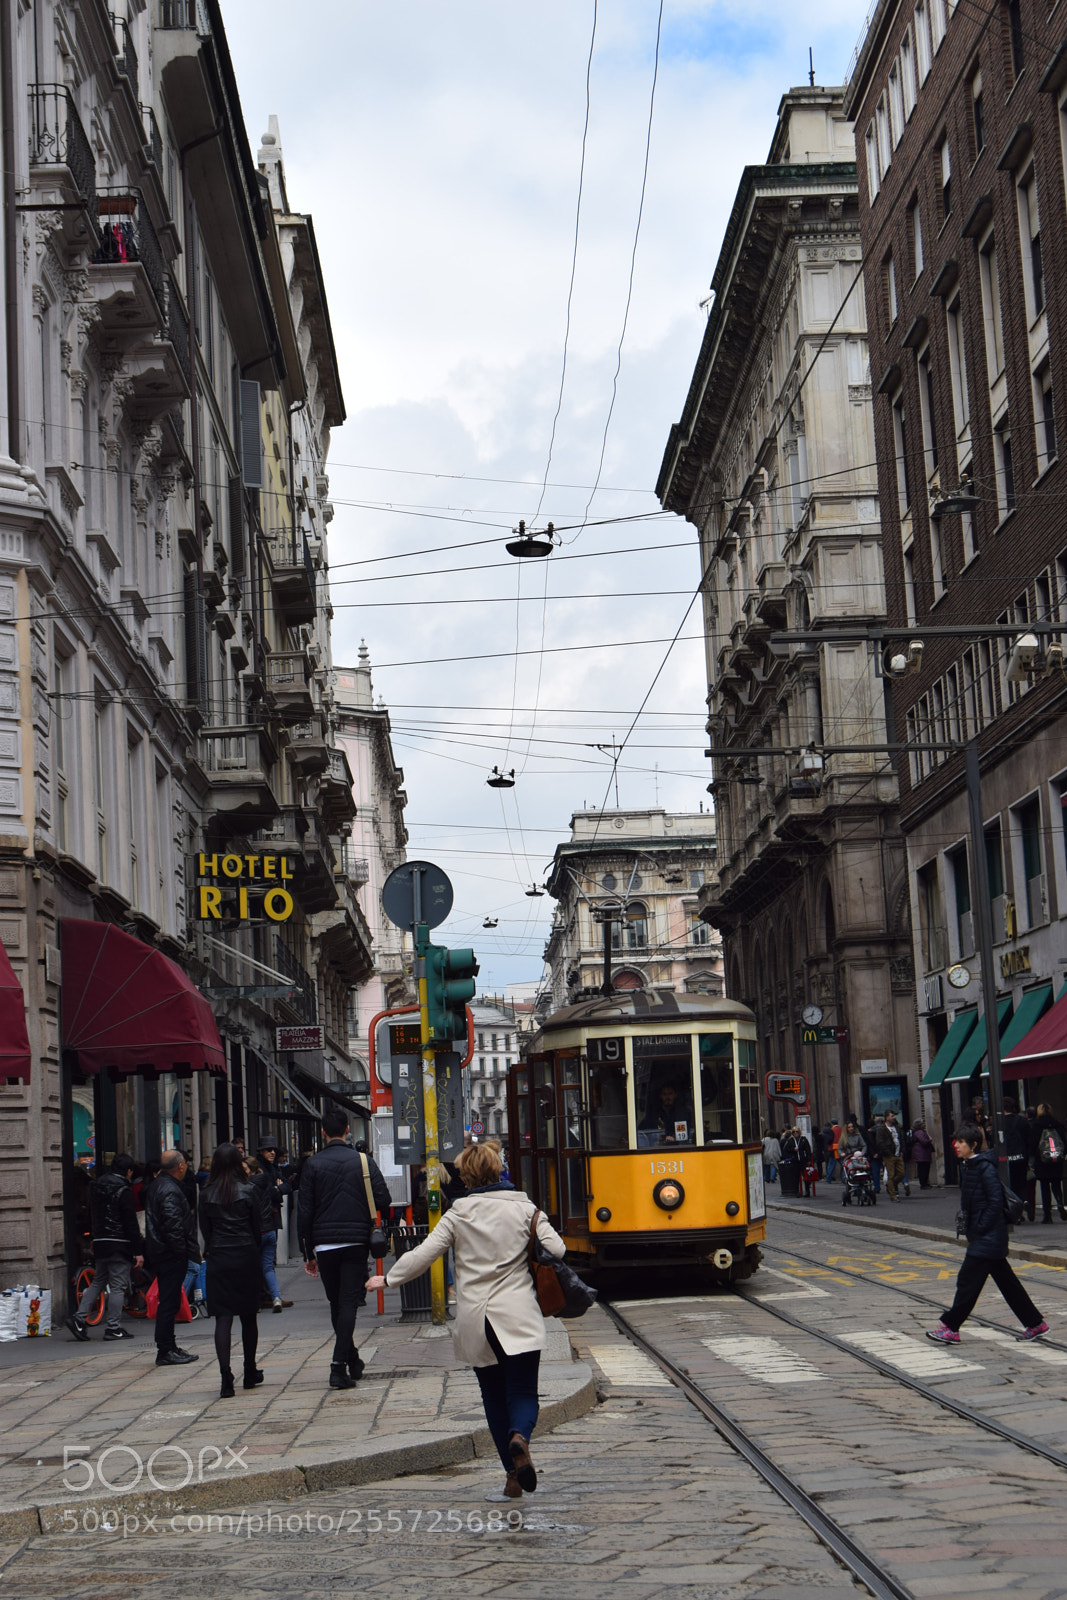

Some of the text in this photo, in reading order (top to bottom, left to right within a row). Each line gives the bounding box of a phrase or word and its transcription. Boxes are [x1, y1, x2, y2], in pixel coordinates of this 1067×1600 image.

[199, 853, 293, 879] HOTEL
[200, 885, 294, 921] RIO
[597, 1039, 620, 1061] 19
[650, 1160, 684, 1175] 1531
